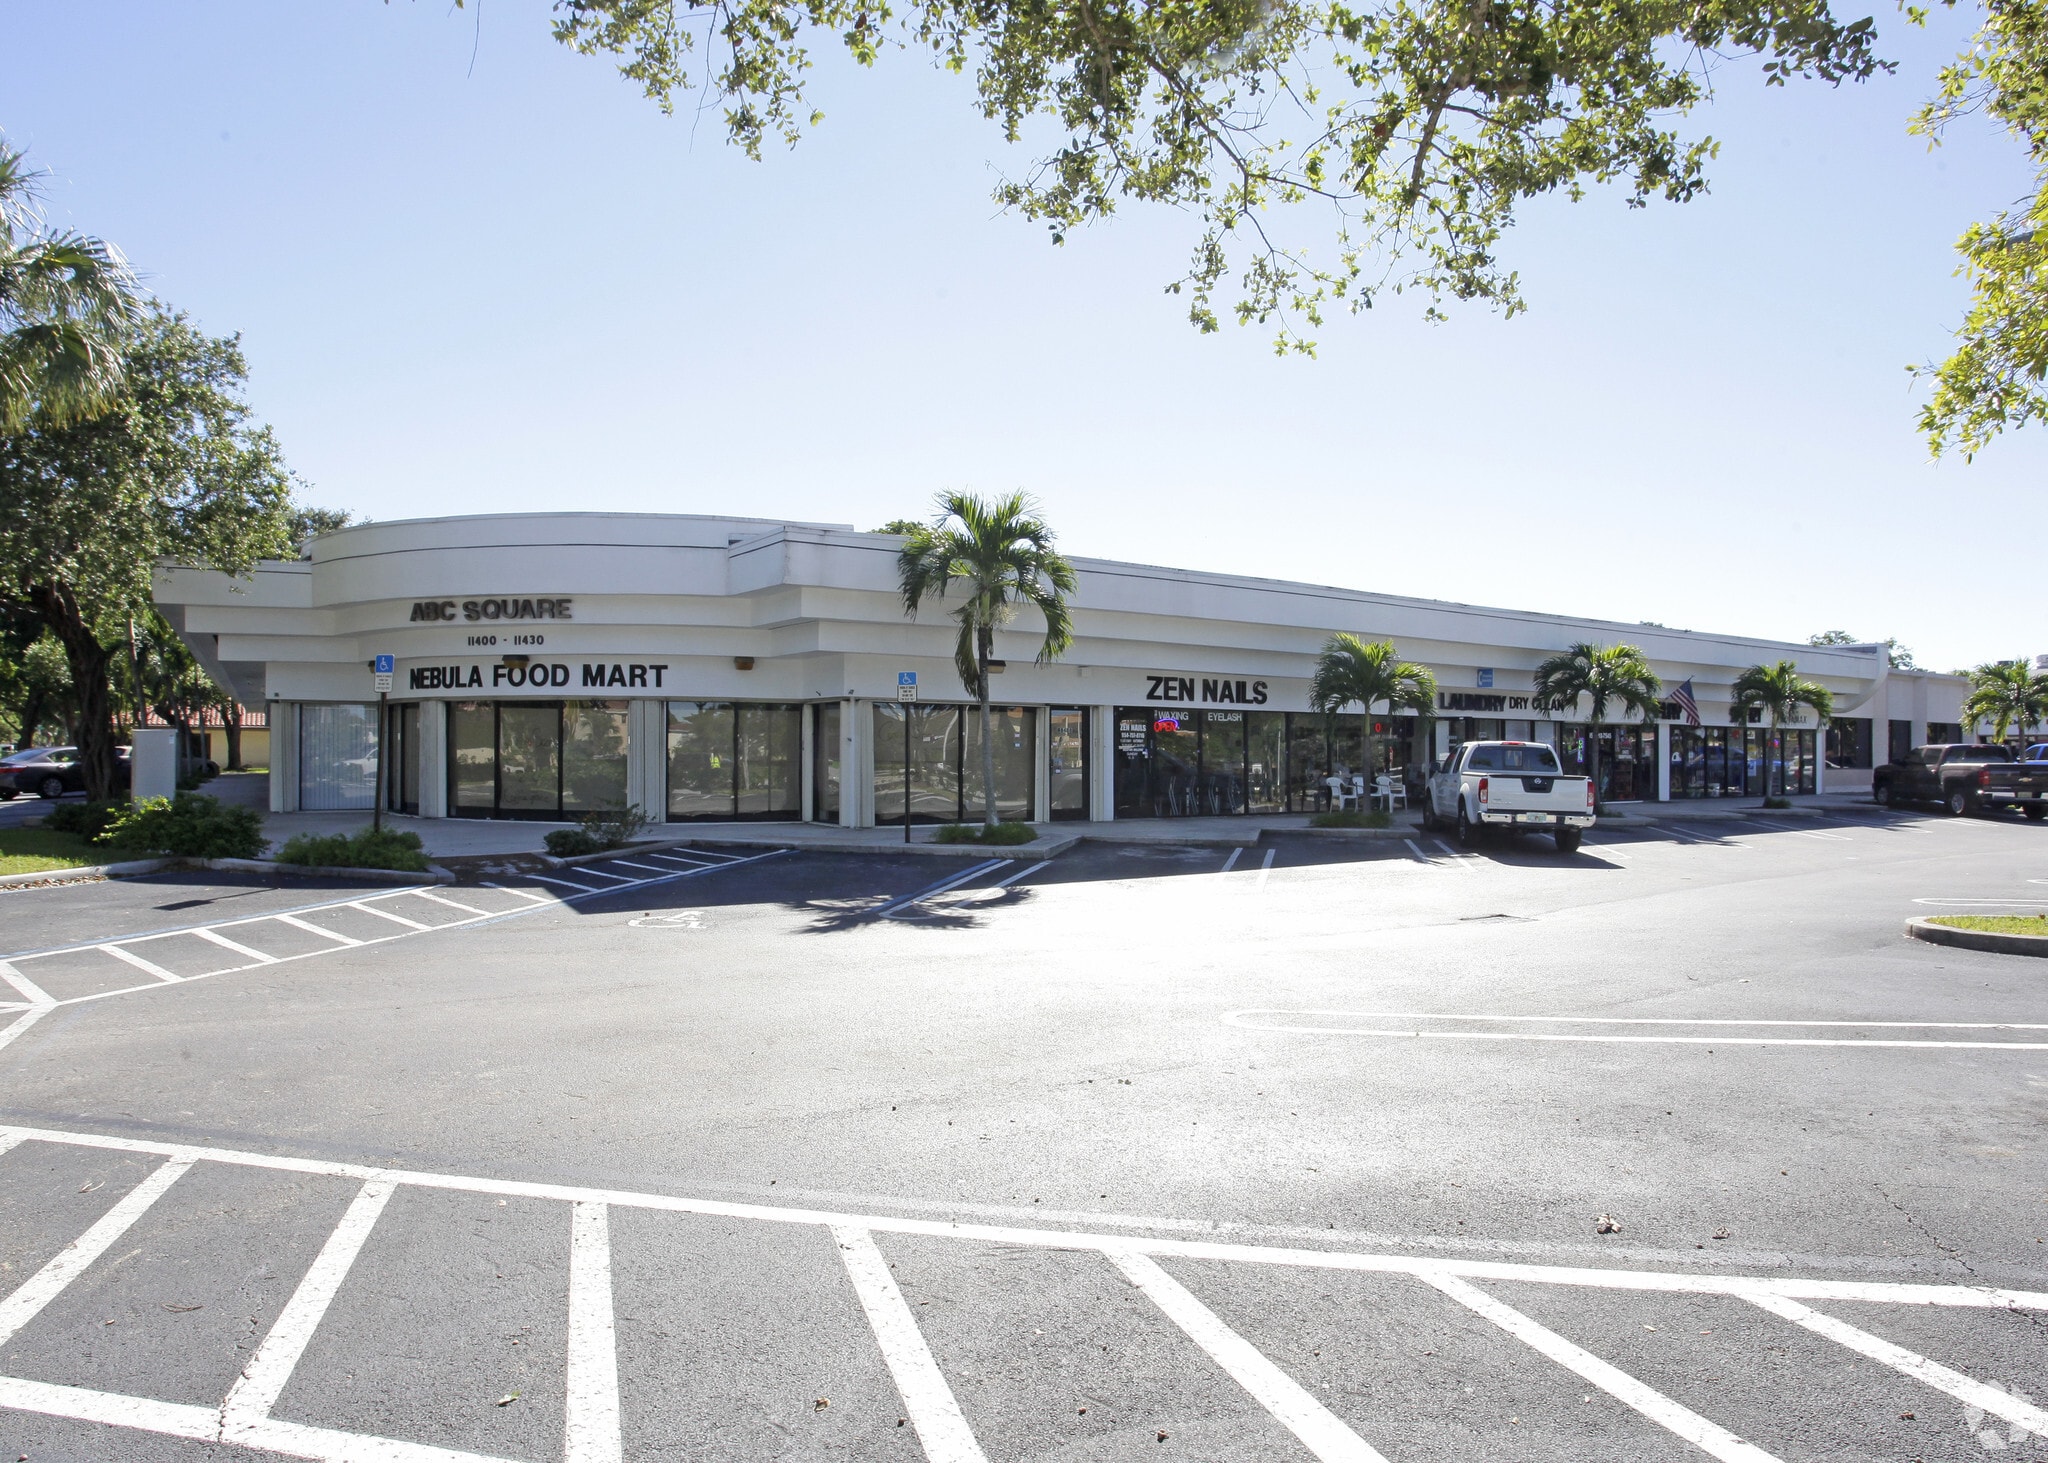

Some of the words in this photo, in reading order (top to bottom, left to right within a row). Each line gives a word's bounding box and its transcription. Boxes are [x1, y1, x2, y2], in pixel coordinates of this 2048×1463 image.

[410, 600, 456, 622] ABC
[463, 599, 573, 621] SQUARE
[467, 635, 497, 646] 11400
[514, 635, 545, 646] 11430
[409, 665, 483, 690] NEBULA
[493, 664, 570, 688] FOOD
[582, 664, 669, 688] MART
[1146, 675, 1195, 702] ZEN
[1202, 678, 1268, 704] NAILS
[1439, 692, 1507, 712] LAUNDRY
[1508, 696, 1530, 710] DRY
[1158, 711, 1189, 721] WAXING
[1207, 712, 1242, 722] EYELASH
